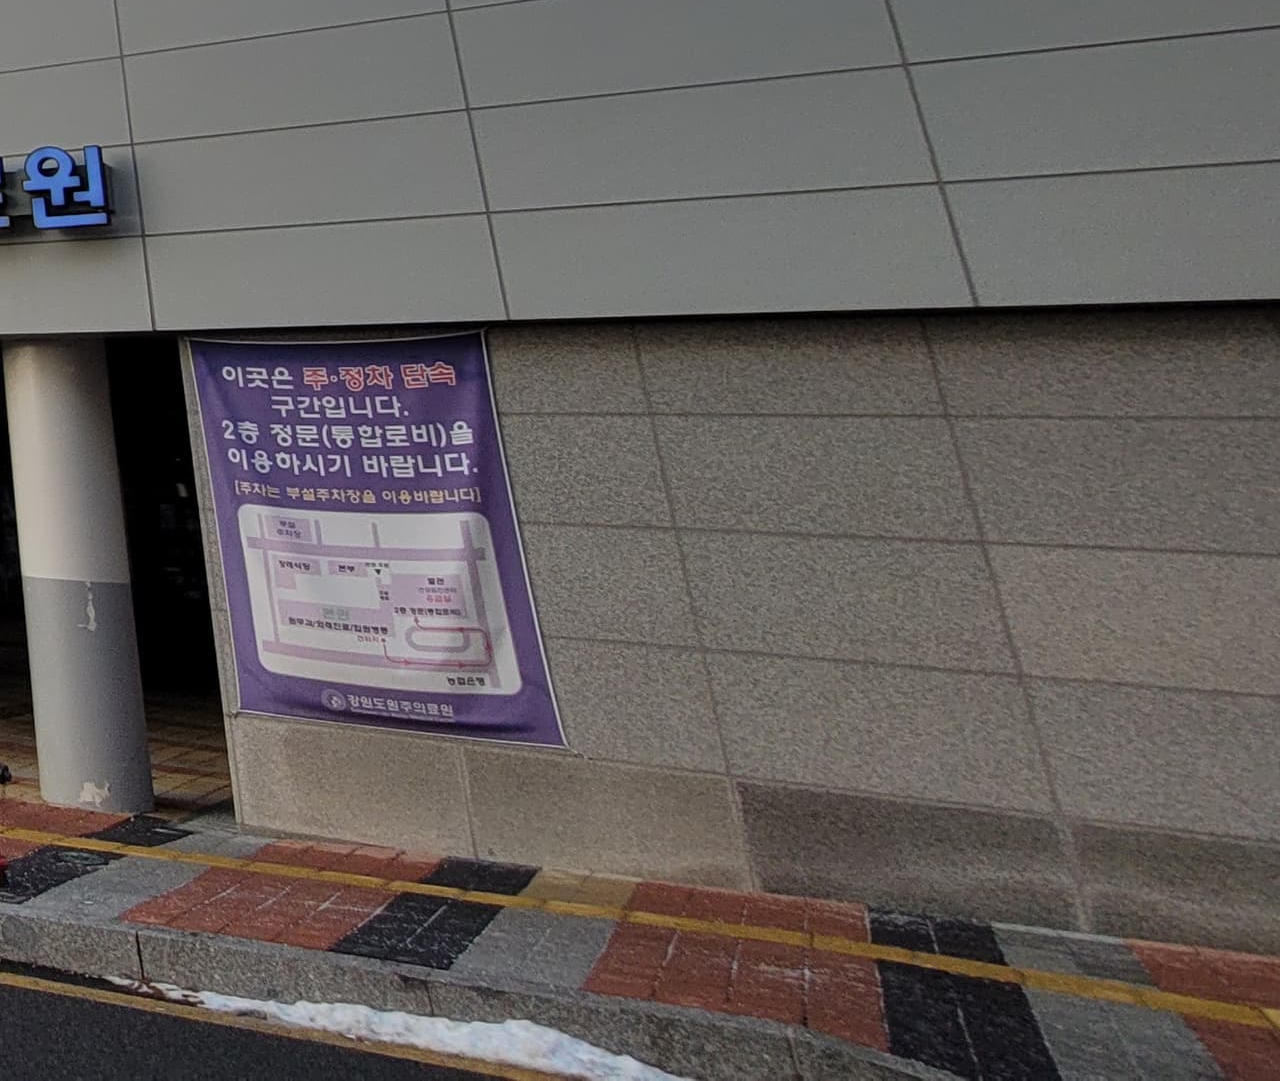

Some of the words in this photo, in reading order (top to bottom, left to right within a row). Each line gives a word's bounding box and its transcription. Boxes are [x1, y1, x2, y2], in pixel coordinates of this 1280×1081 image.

[222, 366, 294, 389] 이곳은
[401, 362, 456, 389] 단속
[271, 395, 409, 418] 구간입니다.
[222, 420, 260, 445] 2층
[270, 421, 474, 448] 정문(통합로비)을
[228, 448, 350, 477] 이용하시기
[362, 452, 479, 478] 바랍니다.
[286, 486, 377, 504] 부설주차장을
